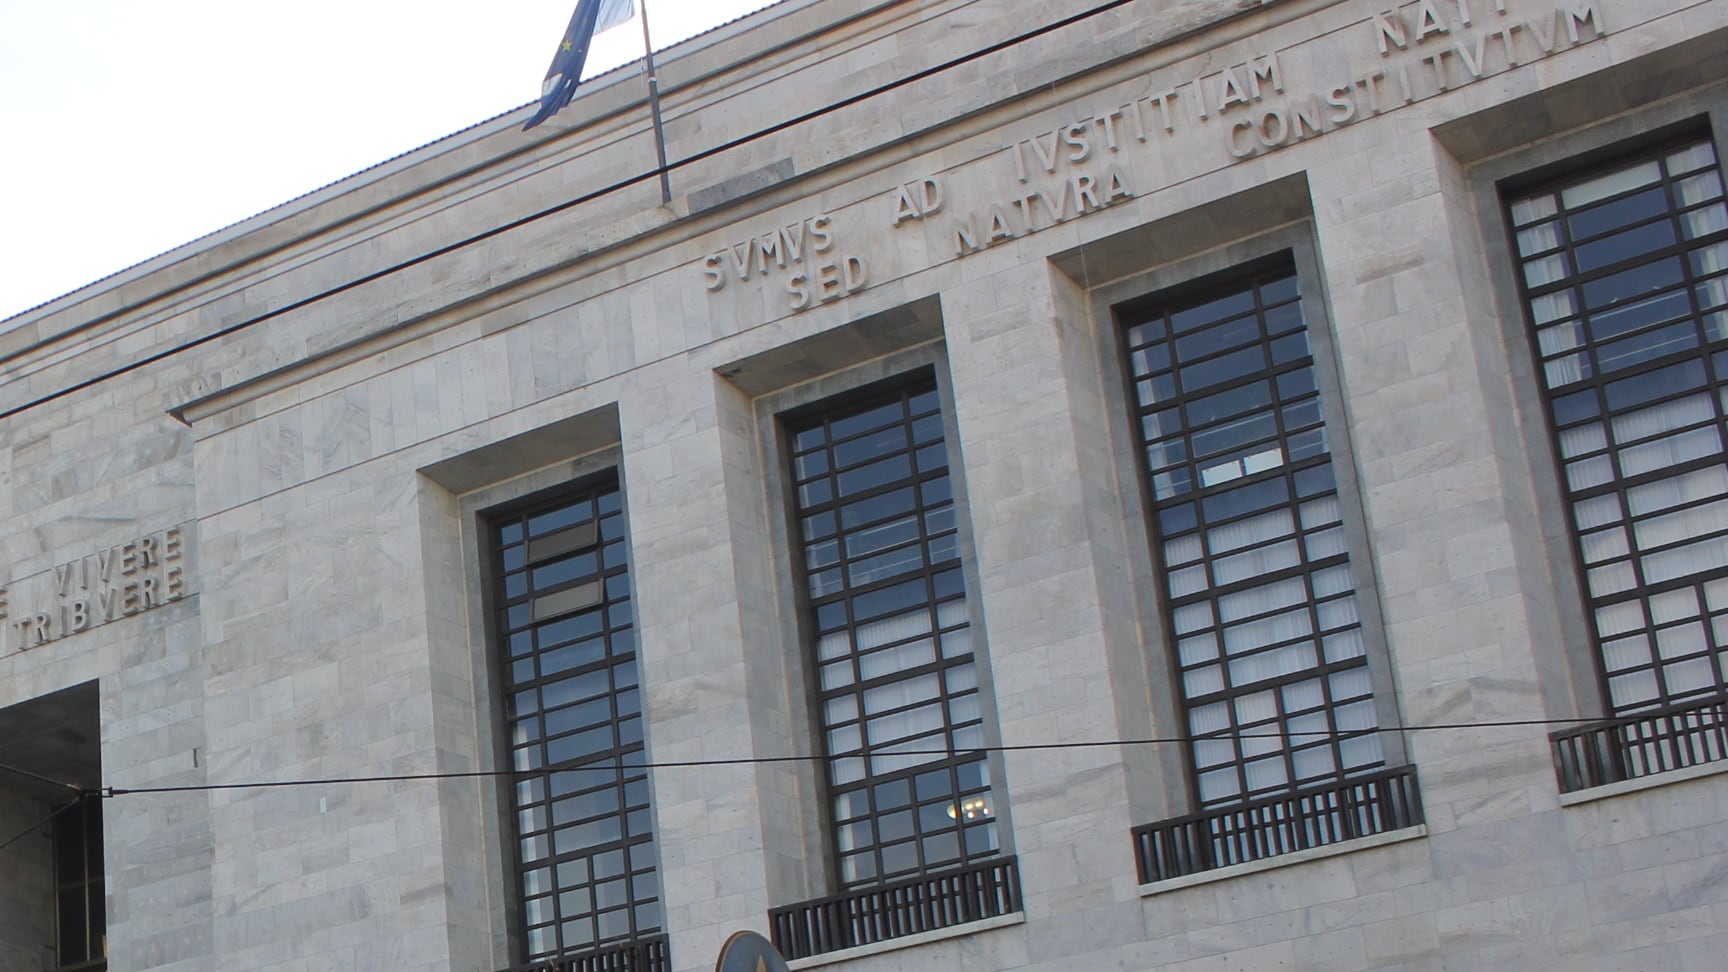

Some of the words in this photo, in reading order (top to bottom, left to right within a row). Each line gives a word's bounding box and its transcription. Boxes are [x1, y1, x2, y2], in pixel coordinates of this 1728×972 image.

[703, 213, 835, 293] SVMVS
[890, 174, 945, 228] AD
[1010, 51, 1284, 184] IVSTITIAM
[786, 255, 872, 311] SED
[953, 162, 1139, 256] NATVRA
[1224, 2, 1608, 160] CONSTITVTVM
[13, 564, 185, 652] TRIBVERE
[53, 526, 184, 598] VIVERE
